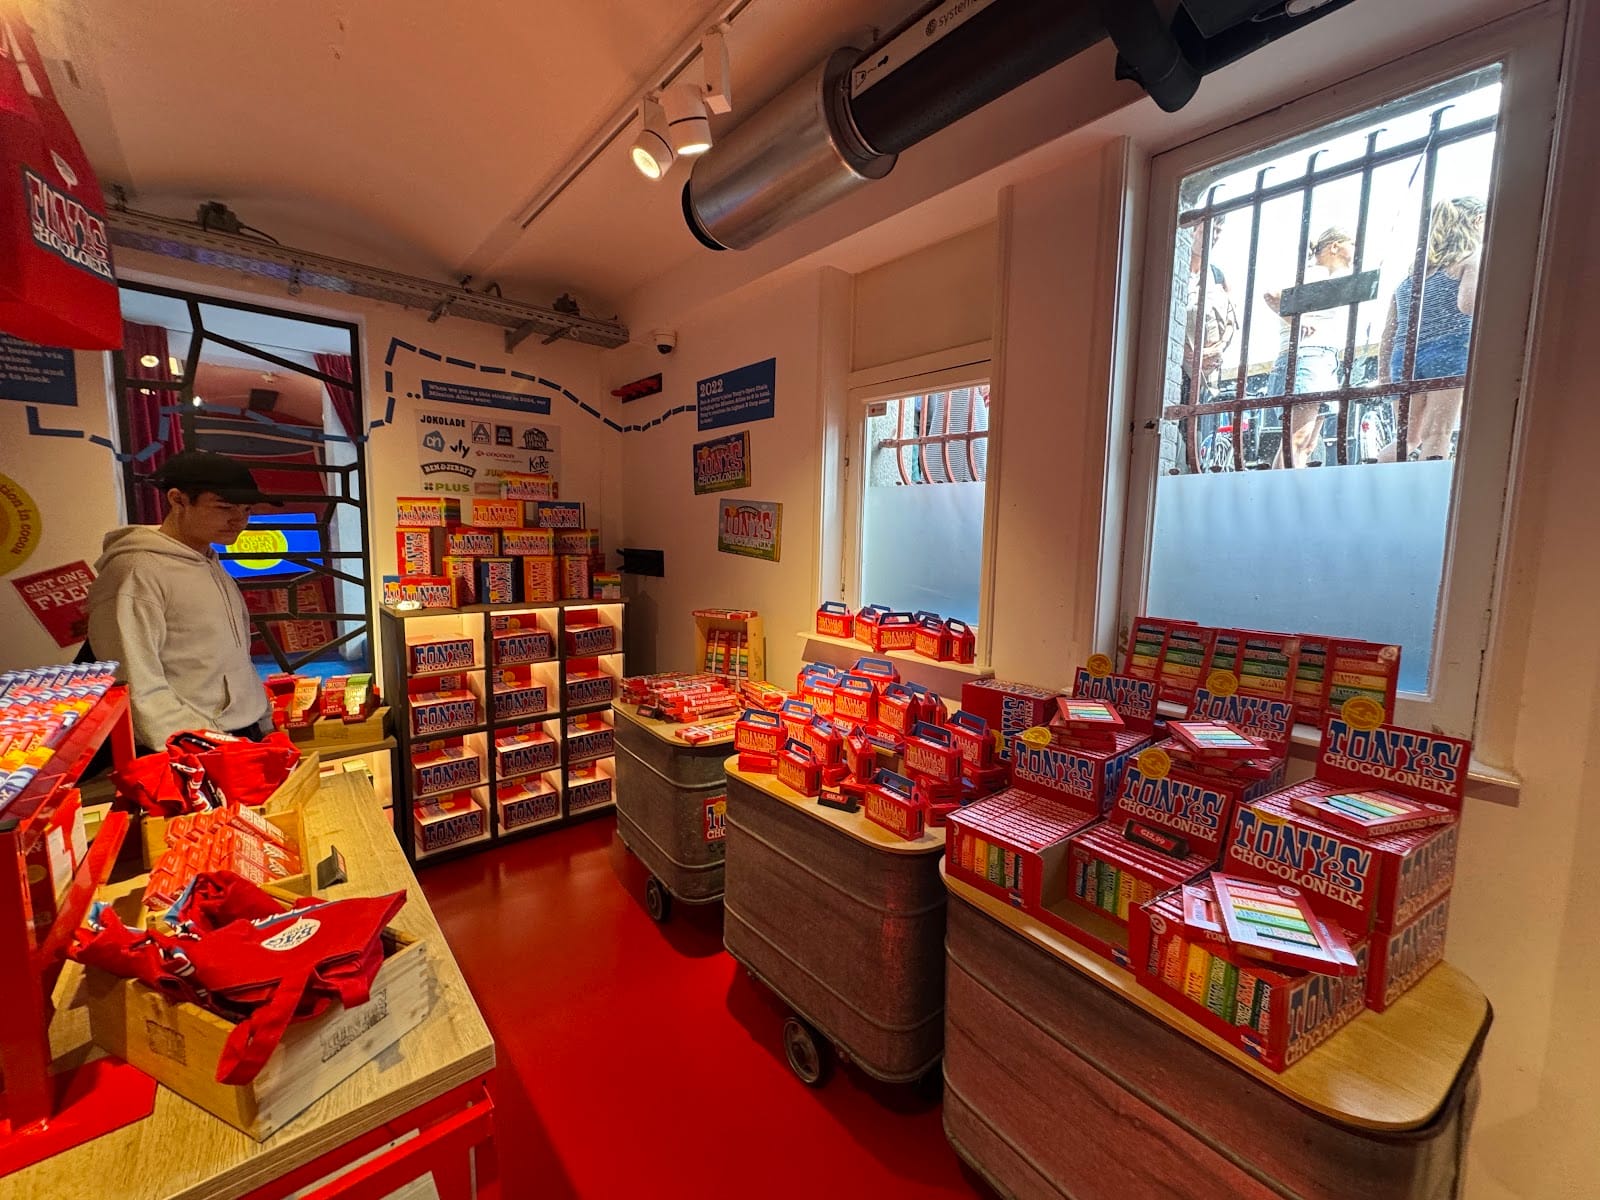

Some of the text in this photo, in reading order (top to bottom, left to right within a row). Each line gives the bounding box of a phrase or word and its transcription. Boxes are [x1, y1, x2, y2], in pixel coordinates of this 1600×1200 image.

[700, 379, 724, 397] 2022
[420, 414, 465, 428] JOKOLADE
[697, 440, 743, 476] TONY'S
[435, 482, 470, 493] PLUS
[724, 507, 774, 540] TONY'S
[241, 542, 274, 551] OPEN
[24, 579, 54, 595] GET
[57, 568, 89, 585] ONE
[414, 641, 472, 665] TONY'S
[498, 636, 550, 657] TONY'S
[416, 660, 473, 672] CHOCOLONELY
[495, 690, 544, 711] TONY'S
[1078, 670, 1156, 710] TONY'S
[417, 701, 475, 726] TONY'S
[1194, 688, 1293, 732] TONY'S
[504, 745, 553, 769] TONY'S
[1327, 718, 1463, 782] TONY'S
[421, 760, 478, 786] TONY'S
[1015, 740, 1095, 792] TONY'S
[1323, 752, 1457, 798] CHOCOLONELY
[1015, 767, 1095, 802] CHOCOLONELY
[1124, 766, 1226, 829] TONY'S
[425, 814, 481, 842] TONY'S
[1118, 798, 1217, 843] CHOCOLONELY
[1234, 807, 1371, 894] TONY'S
[1231, 845, 1364, 911] CHOCOLONELY
